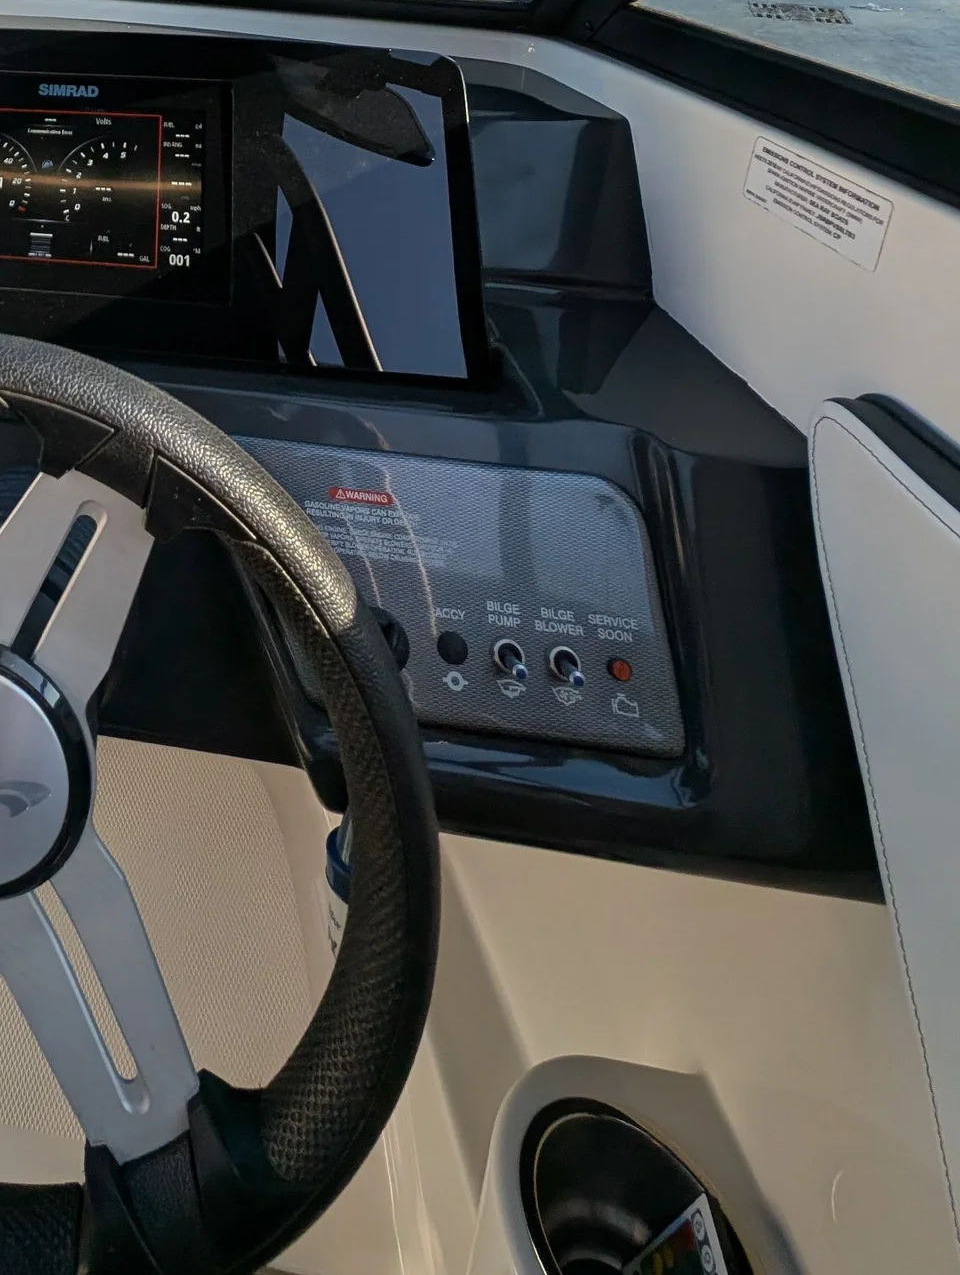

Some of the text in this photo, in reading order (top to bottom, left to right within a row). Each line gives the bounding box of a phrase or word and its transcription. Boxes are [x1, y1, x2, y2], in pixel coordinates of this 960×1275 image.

[39, 84, 99, 97] SIMRAD
[762, 145, 880, 212] EMISSIONS CONTROL SYSTEM INFORMATION
[172, 211, 190, 224] 0.2
[98, 235, 109, 243] FUEL
[169, 254, 190, 267] 001
[346, 491, 388, 503] WARNING
[304, 501, 340, 511] GASOLINE
[342, 504, 370, 514] VAPORS
[371, 508, 387, 516] CAN
[306, 509, 345, 519] RESULTING
[355, 514, 381, 524] INJURY
[436, 608, 465, 620] ACCY
[486, 601, 521, 615] BILGE
[541, 607, 575, 622] BILGE
[489, 615, 521, 628] PUMP
[534, 620, 584, 636] BLOWER
[588, 614, 639, 630] SERVICE
[597, 628, 633, 642] SOON
